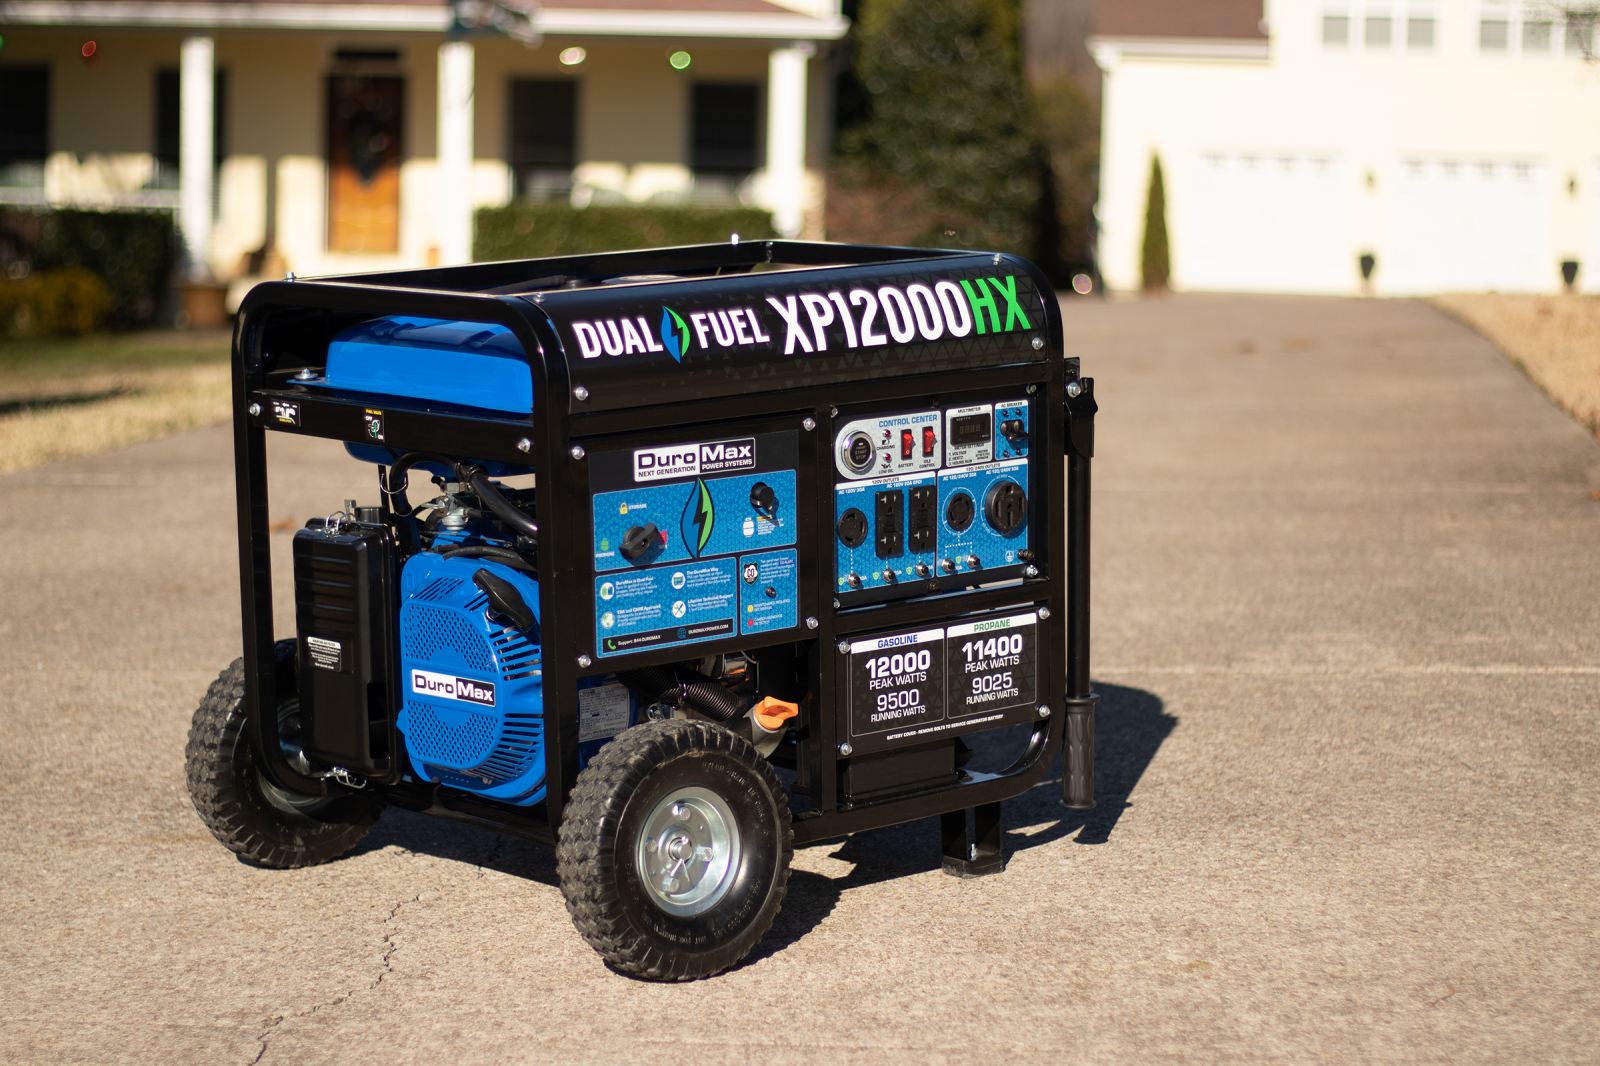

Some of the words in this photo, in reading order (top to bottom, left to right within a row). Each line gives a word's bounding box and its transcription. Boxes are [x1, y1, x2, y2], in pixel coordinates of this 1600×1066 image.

[571, 318, 663, 359] DUAL
[689, 308, 770, 348] FUEL
[766, 276, 1031, 354] XP12000HX
[879, 418, 910, 428] CONTROL
[912, 414, 938, 423] CENTER
[656, 465, 696, 475] GENERATION
[725, 459, 752, 468] SYSTEMS
[974, 619, 1010, 632] PROPANE
[877, 635, 918, 648] GASOLINE
[962, 634, 1022, 661] 11400
[865, 650, 930, 678] 12000
[965, 662, 988, 673] PEAK
[990, 655, 1019, 669] WATTS
[869, 679, 894, 690] PEAK
[896, 671, 927, 686] WATTS
[972, 672, 1012, 694] 9025
[877, 689, 919, 711] 9500
[966, 693, 996, 705] RUNNING
[996, 688, 1018, 699] WATTS
[871, 710, 902, 722] RUNNING
[902, 706, 925, 717] WATTS
[967, 717, 988, 725] GENERATOR
